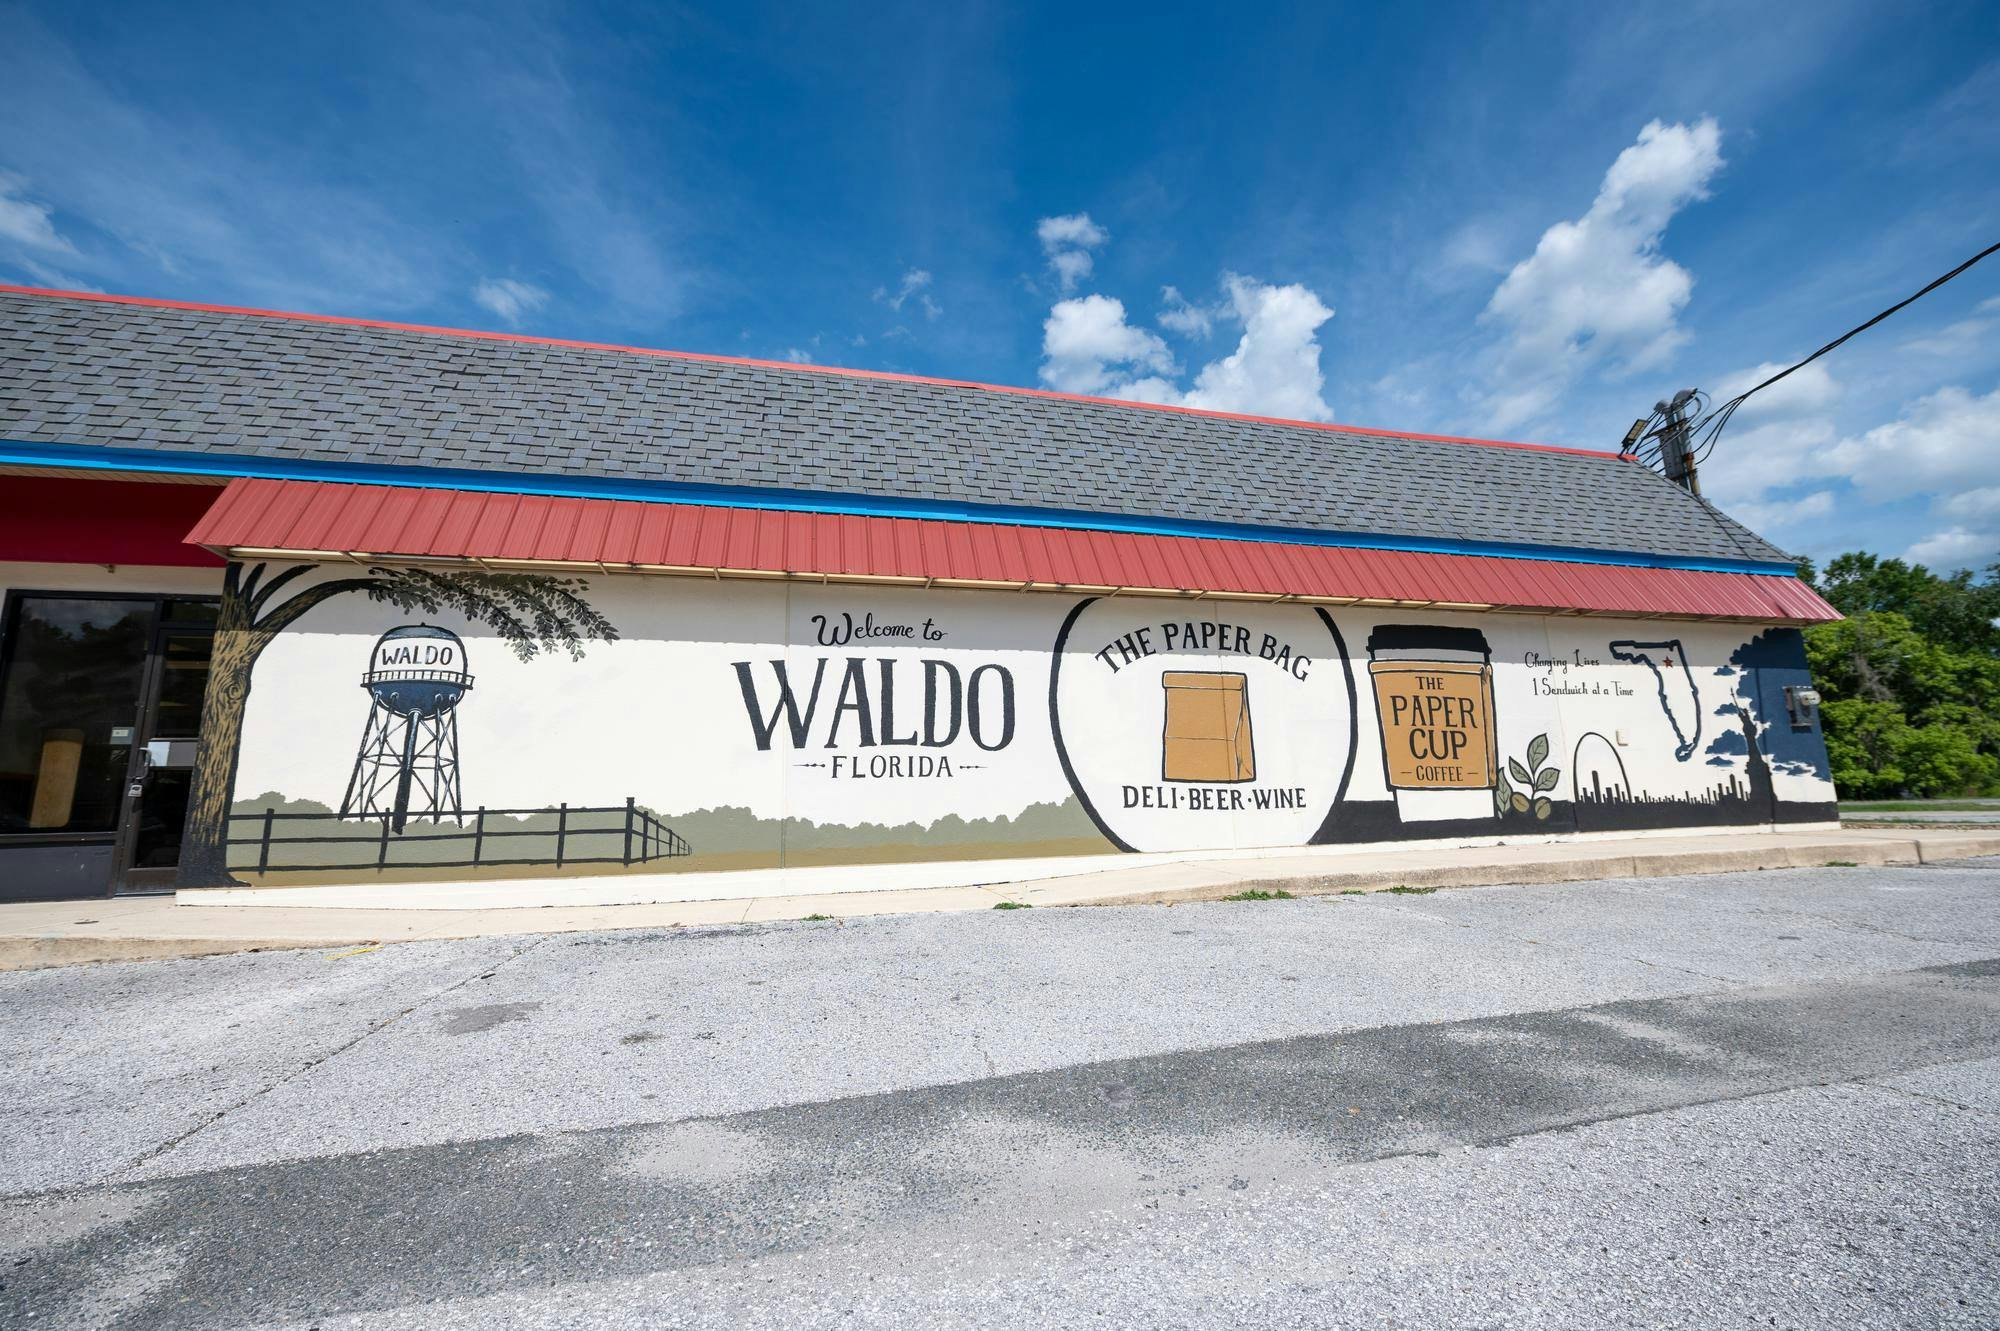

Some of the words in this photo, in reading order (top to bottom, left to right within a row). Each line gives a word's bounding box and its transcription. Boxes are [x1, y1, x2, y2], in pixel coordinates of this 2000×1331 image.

[811, 612, 915, 646] Welcome
[922, 617, 948, 641] to
[381, 645, 453, 666] WALDO
[1095, 627, 1157, 674] THE
[1161, 622, 1252, 655] PAPER
[1258, 633, 1312, 682] BAG
[1524, 651, 1568, 675] Changing
[1415, 676, 1445, 690] THE
[1542, 678, 1588, 696] Sandwich
[1592, 682, 1601, 695] at
[1611, 681, 1634, 696] Time
[730, 657, 1016, 751] WALDO
[1390, 695, 1478, 729] PAPER
[1409, 728, 1467, 760] CUP
[831, 755, 954, 779] FLORIDA
[1416, 765, 1464, 782] COFFEE
